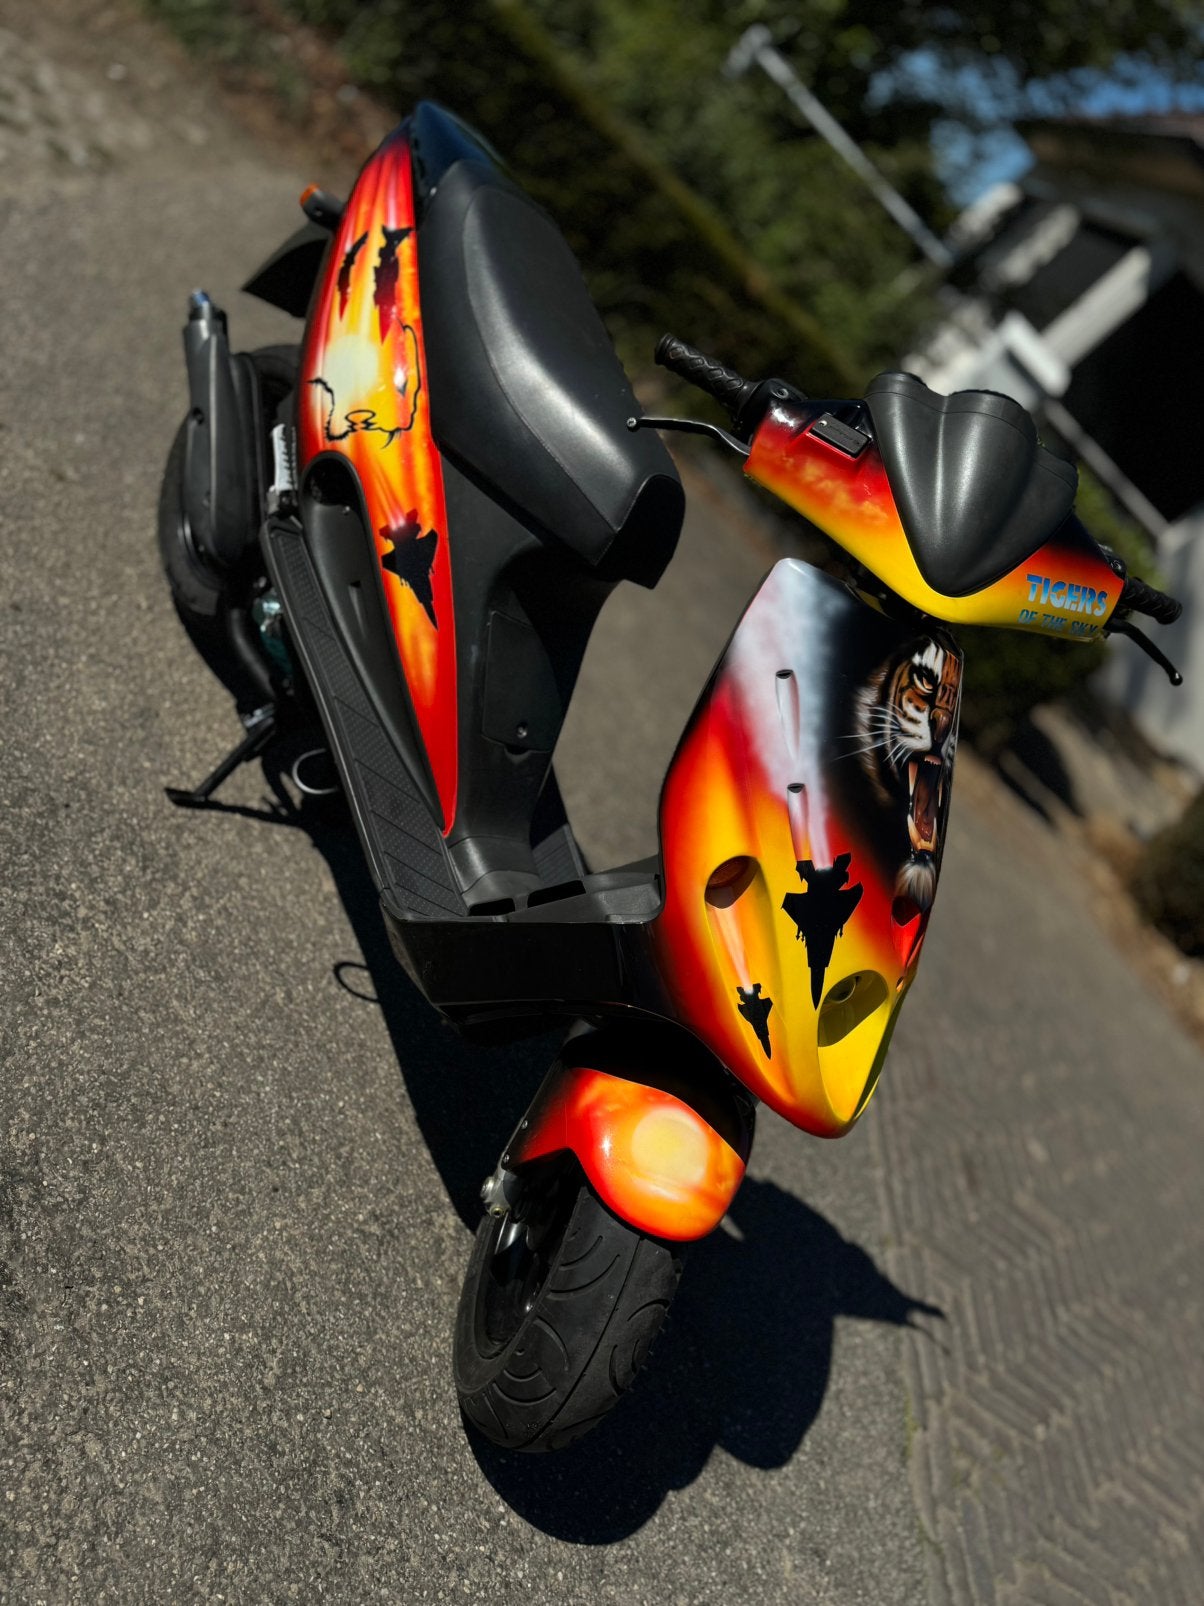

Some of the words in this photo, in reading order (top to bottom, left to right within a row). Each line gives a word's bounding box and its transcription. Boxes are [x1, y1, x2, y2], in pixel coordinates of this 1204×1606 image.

[1026, 574, 1108, 616] TIGERS
[1018, 609, 1038, 624] OF
[1041, 613, 1067, 631] THE
[1070, 620, 1098, 637] SKY
